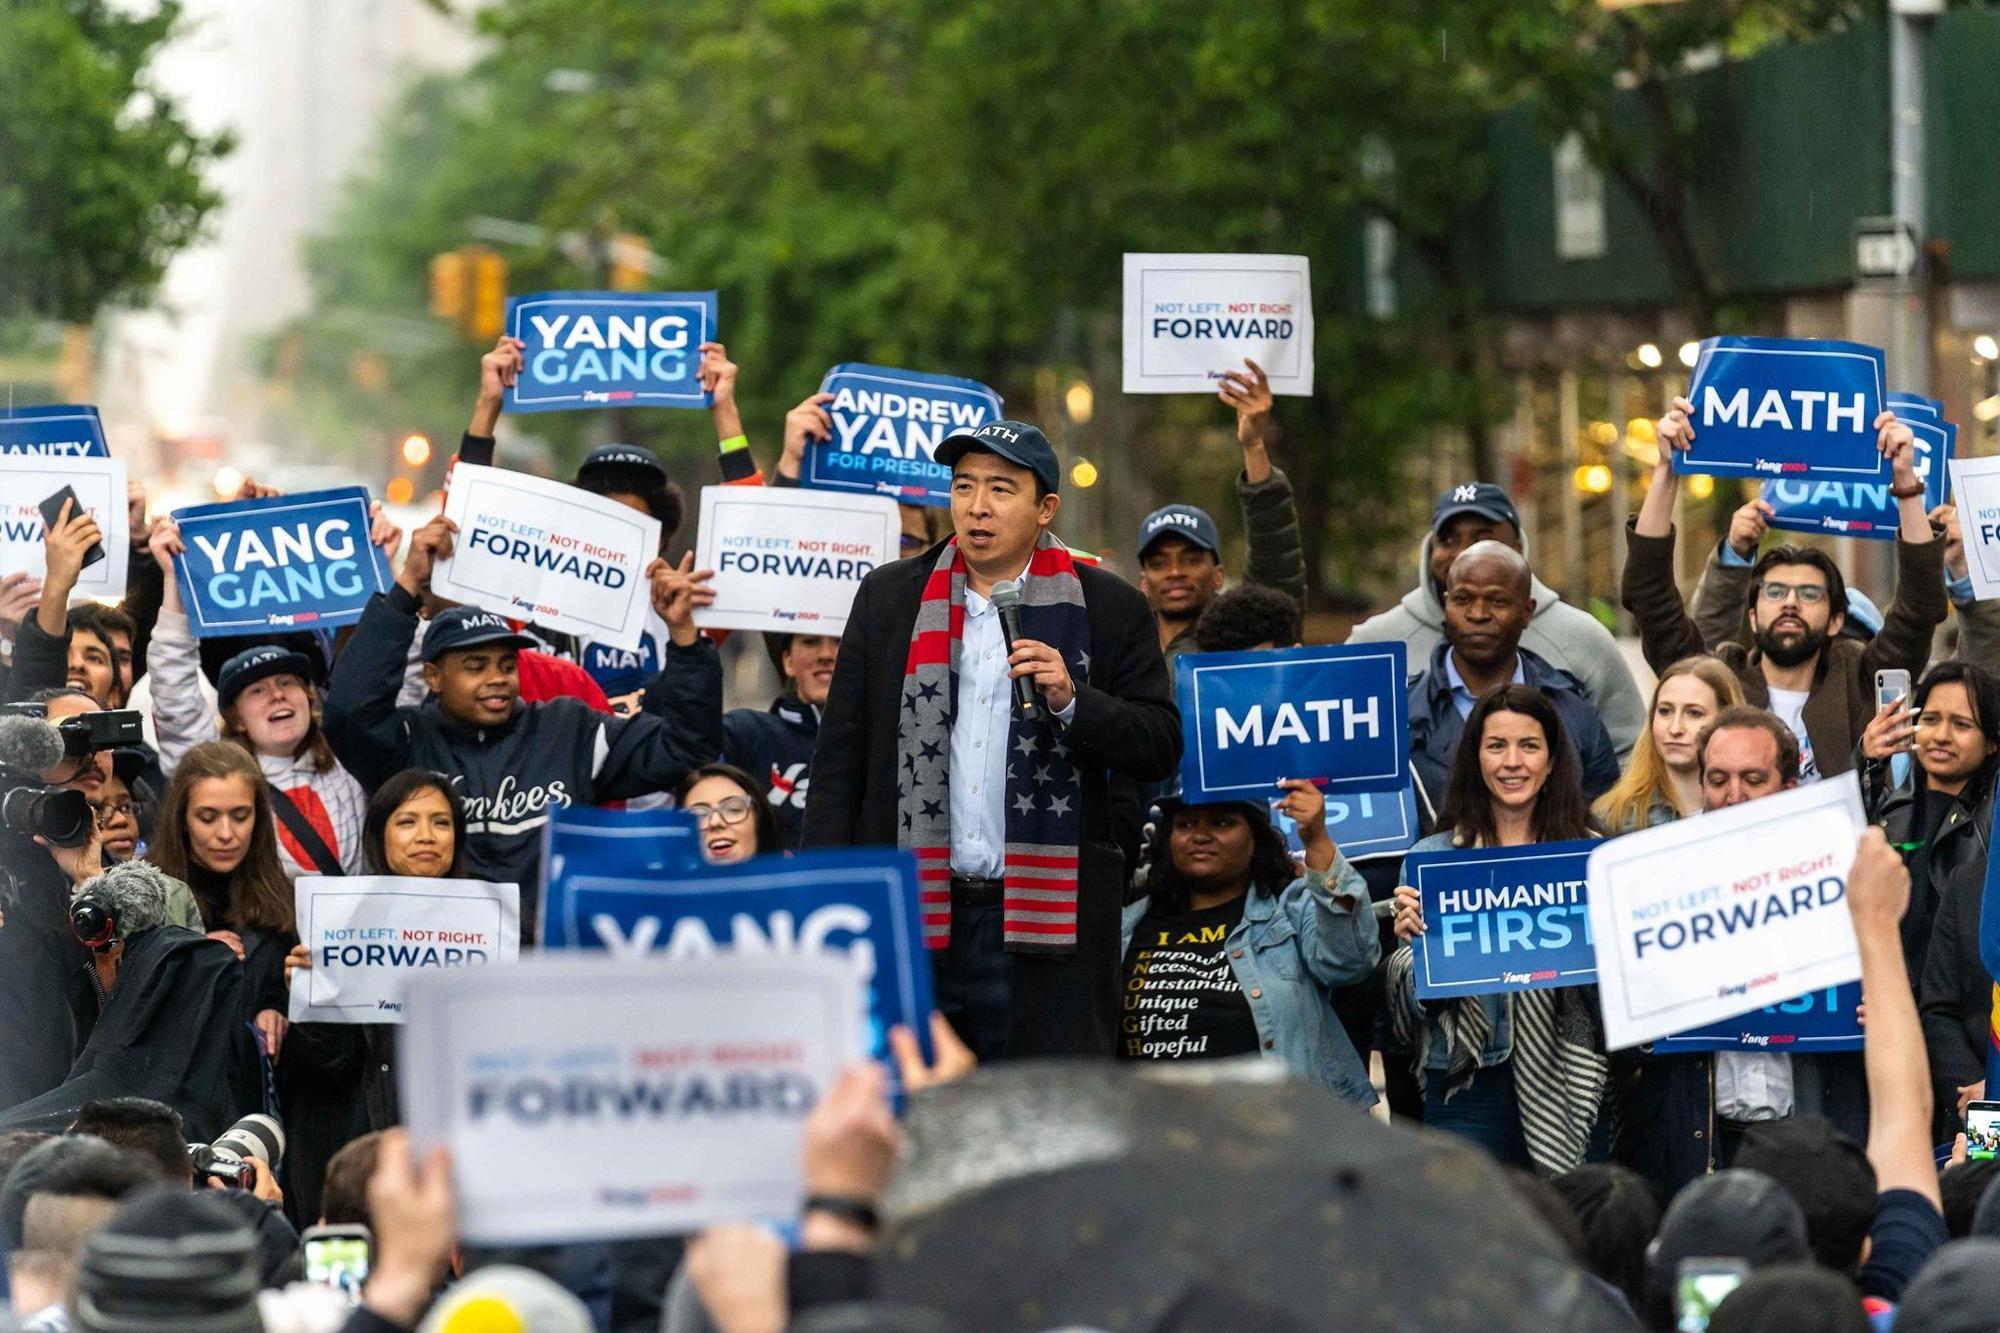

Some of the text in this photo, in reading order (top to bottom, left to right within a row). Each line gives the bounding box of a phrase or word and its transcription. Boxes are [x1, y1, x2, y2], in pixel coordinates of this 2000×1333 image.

[1154, 304, 1184, 313] NOT
[1228, 304, 1257, 313] NOT
[530, 315, 689, 350] YANG
[1153, 318, 1293, 339] FORWARD
[531, 349, 687, 384] GANG
[831, 388, 985, 428] ANDREW
[1703, 386, 1865, 433] MATH
[973, 425, 1019, 443] ATH
[826, 453, 867, 470] FOR
[1756, 458, 1783, 474] Yang
[1453, 484, 1477, 502] NY
[1775, 478, 1901, 511] GAN
[1147, 513, 1198, 533] MATH
[193, 519, 355, 573] YANG
[477, 514, 629, 566] NOT LEFT. NOT RIGHT.
[722, 536, 752, 547] NOT
[798, 540, 827, 552] NOT
[832, 545, 874, 557] RIGHT.
[469, 528, 625, 589] FORWARD
[207, 560, 365, 609] GANG
[511, 594, 559, 616] Yang 2020
[1215, 696, 1379, 750] MATH
[1733, 872, 1772, 894] NOT
[1634, 876, 1846, 958] FORWARD
[324, 928, 487, 944] NOT LEFT. NOT RIGHT.
[1157, 923, 1226, 946] I AM
[323, 944, 489, 968] FORWARD
[1133, 961, 1229, 981] Necessary
[1503, 971, 1531, 984] Yang
[1124, 995, 1199, 1012] Unique
[1123, 1014, 1189, 1035] Gifted
[1127, 1036, 1208, 1059] Hopeful
[1741, 1032, 1770, 1046] Yang
